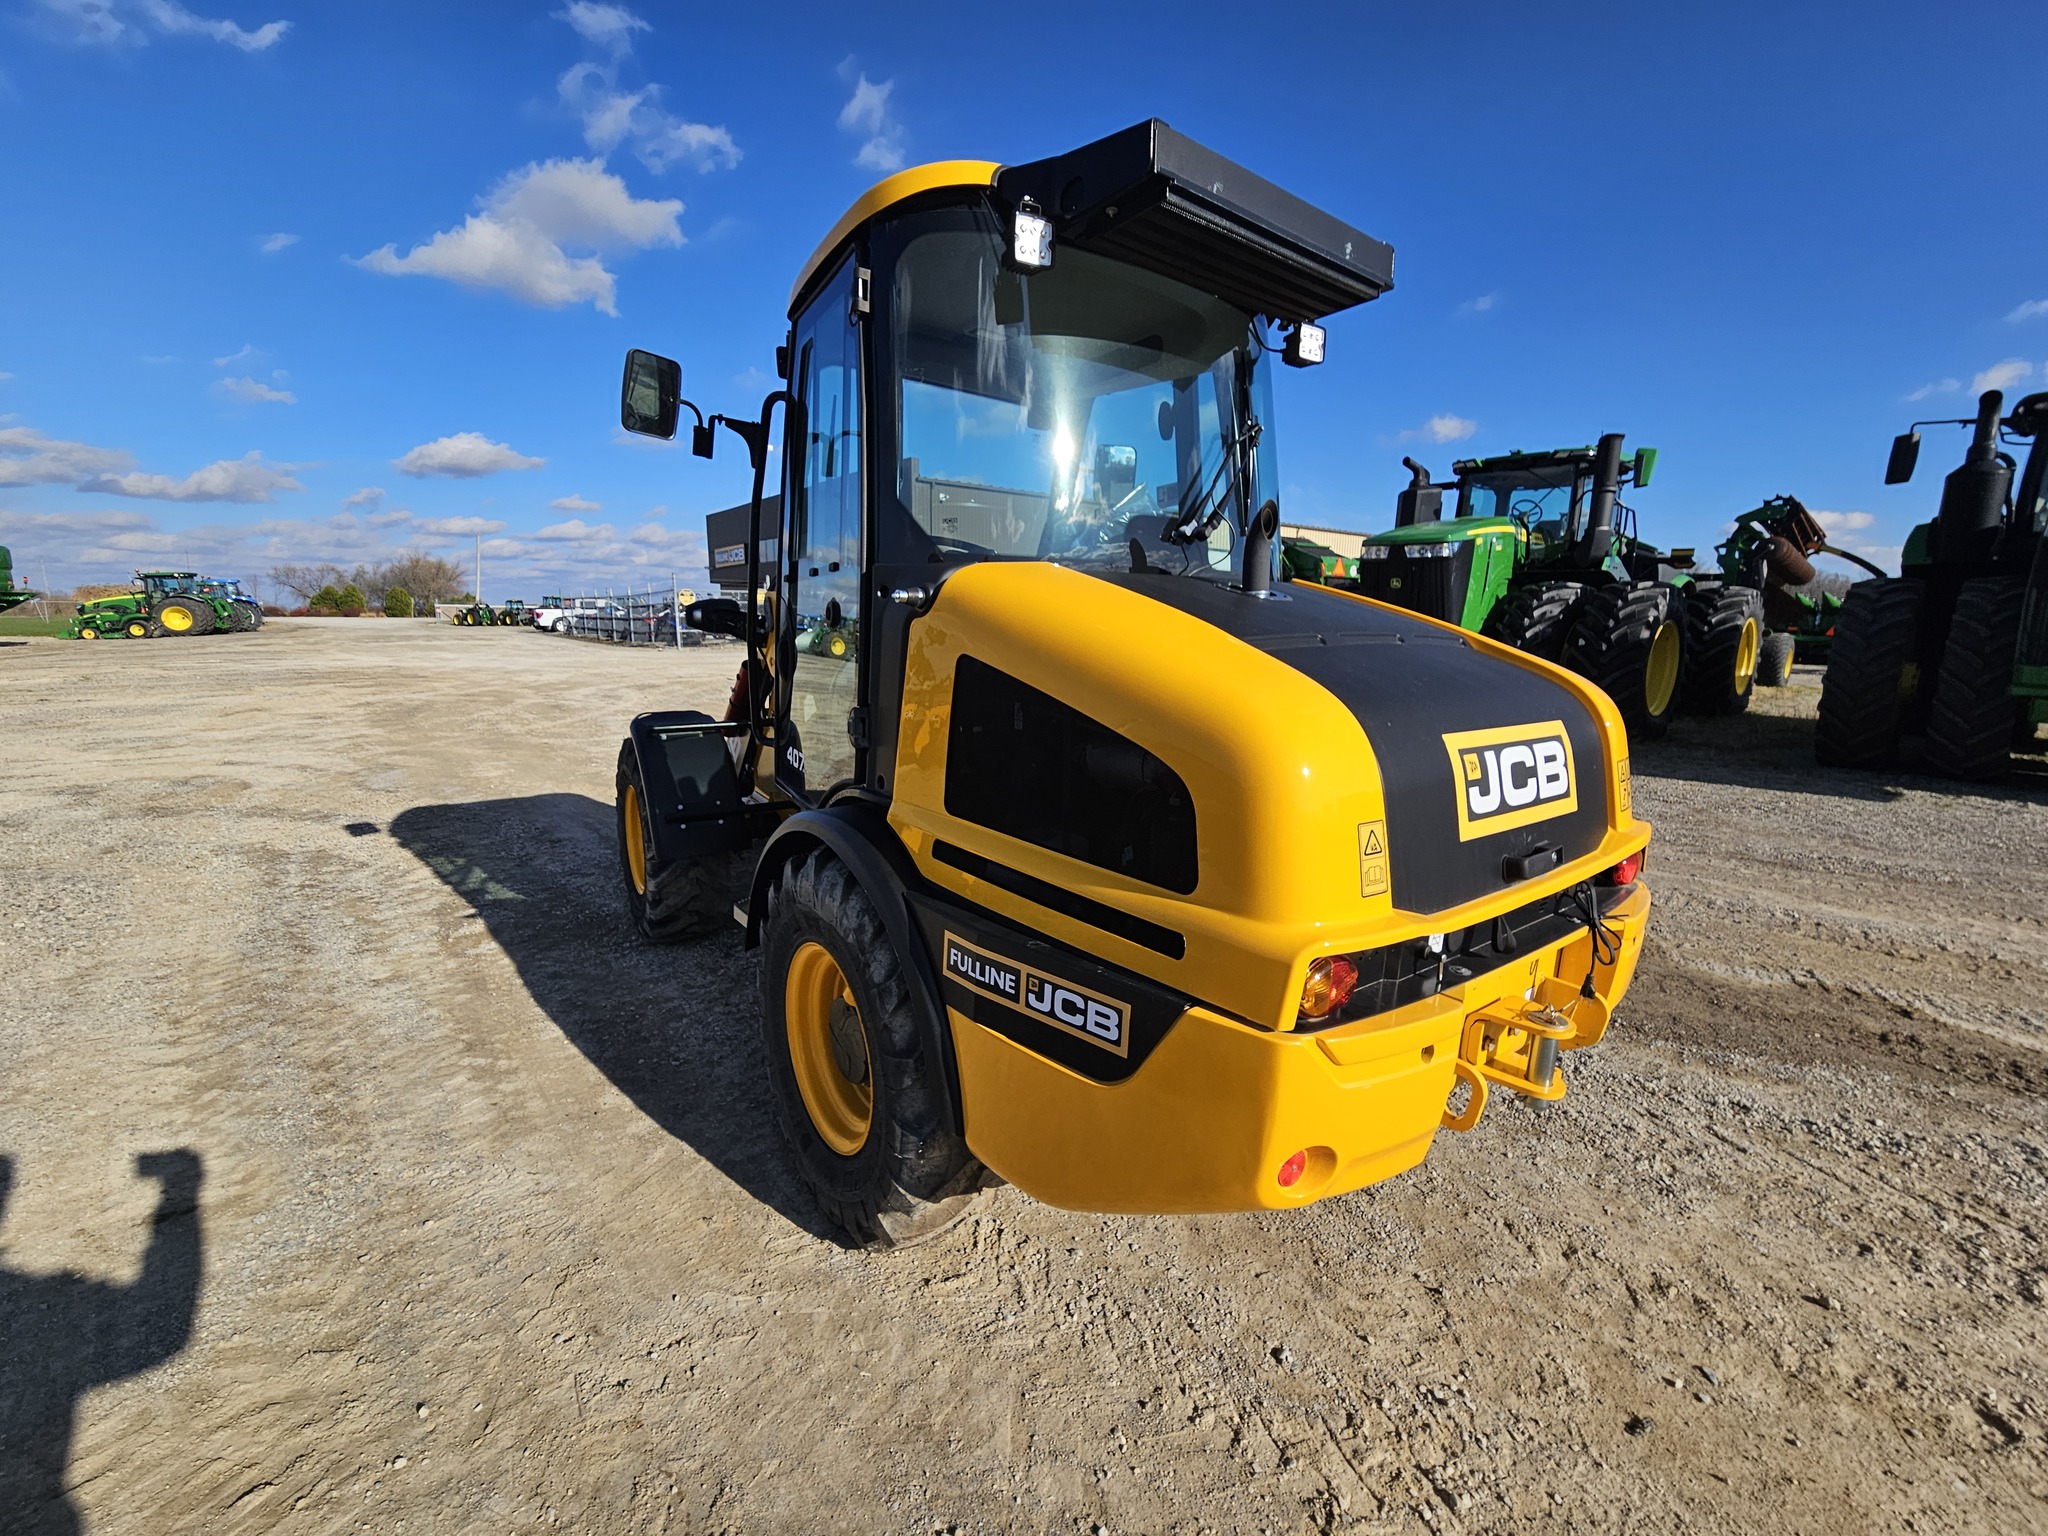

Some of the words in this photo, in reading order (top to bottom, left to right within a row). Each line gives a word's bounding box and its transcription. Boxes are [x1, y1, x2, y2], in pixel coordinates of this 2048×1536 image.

[787, 746, 806, 772] 407
[1469, 740, 1569, 814] JCB
[950, 947, 1016, 994] FULLINE
[1028, 983, 1120, 1041] JCB
